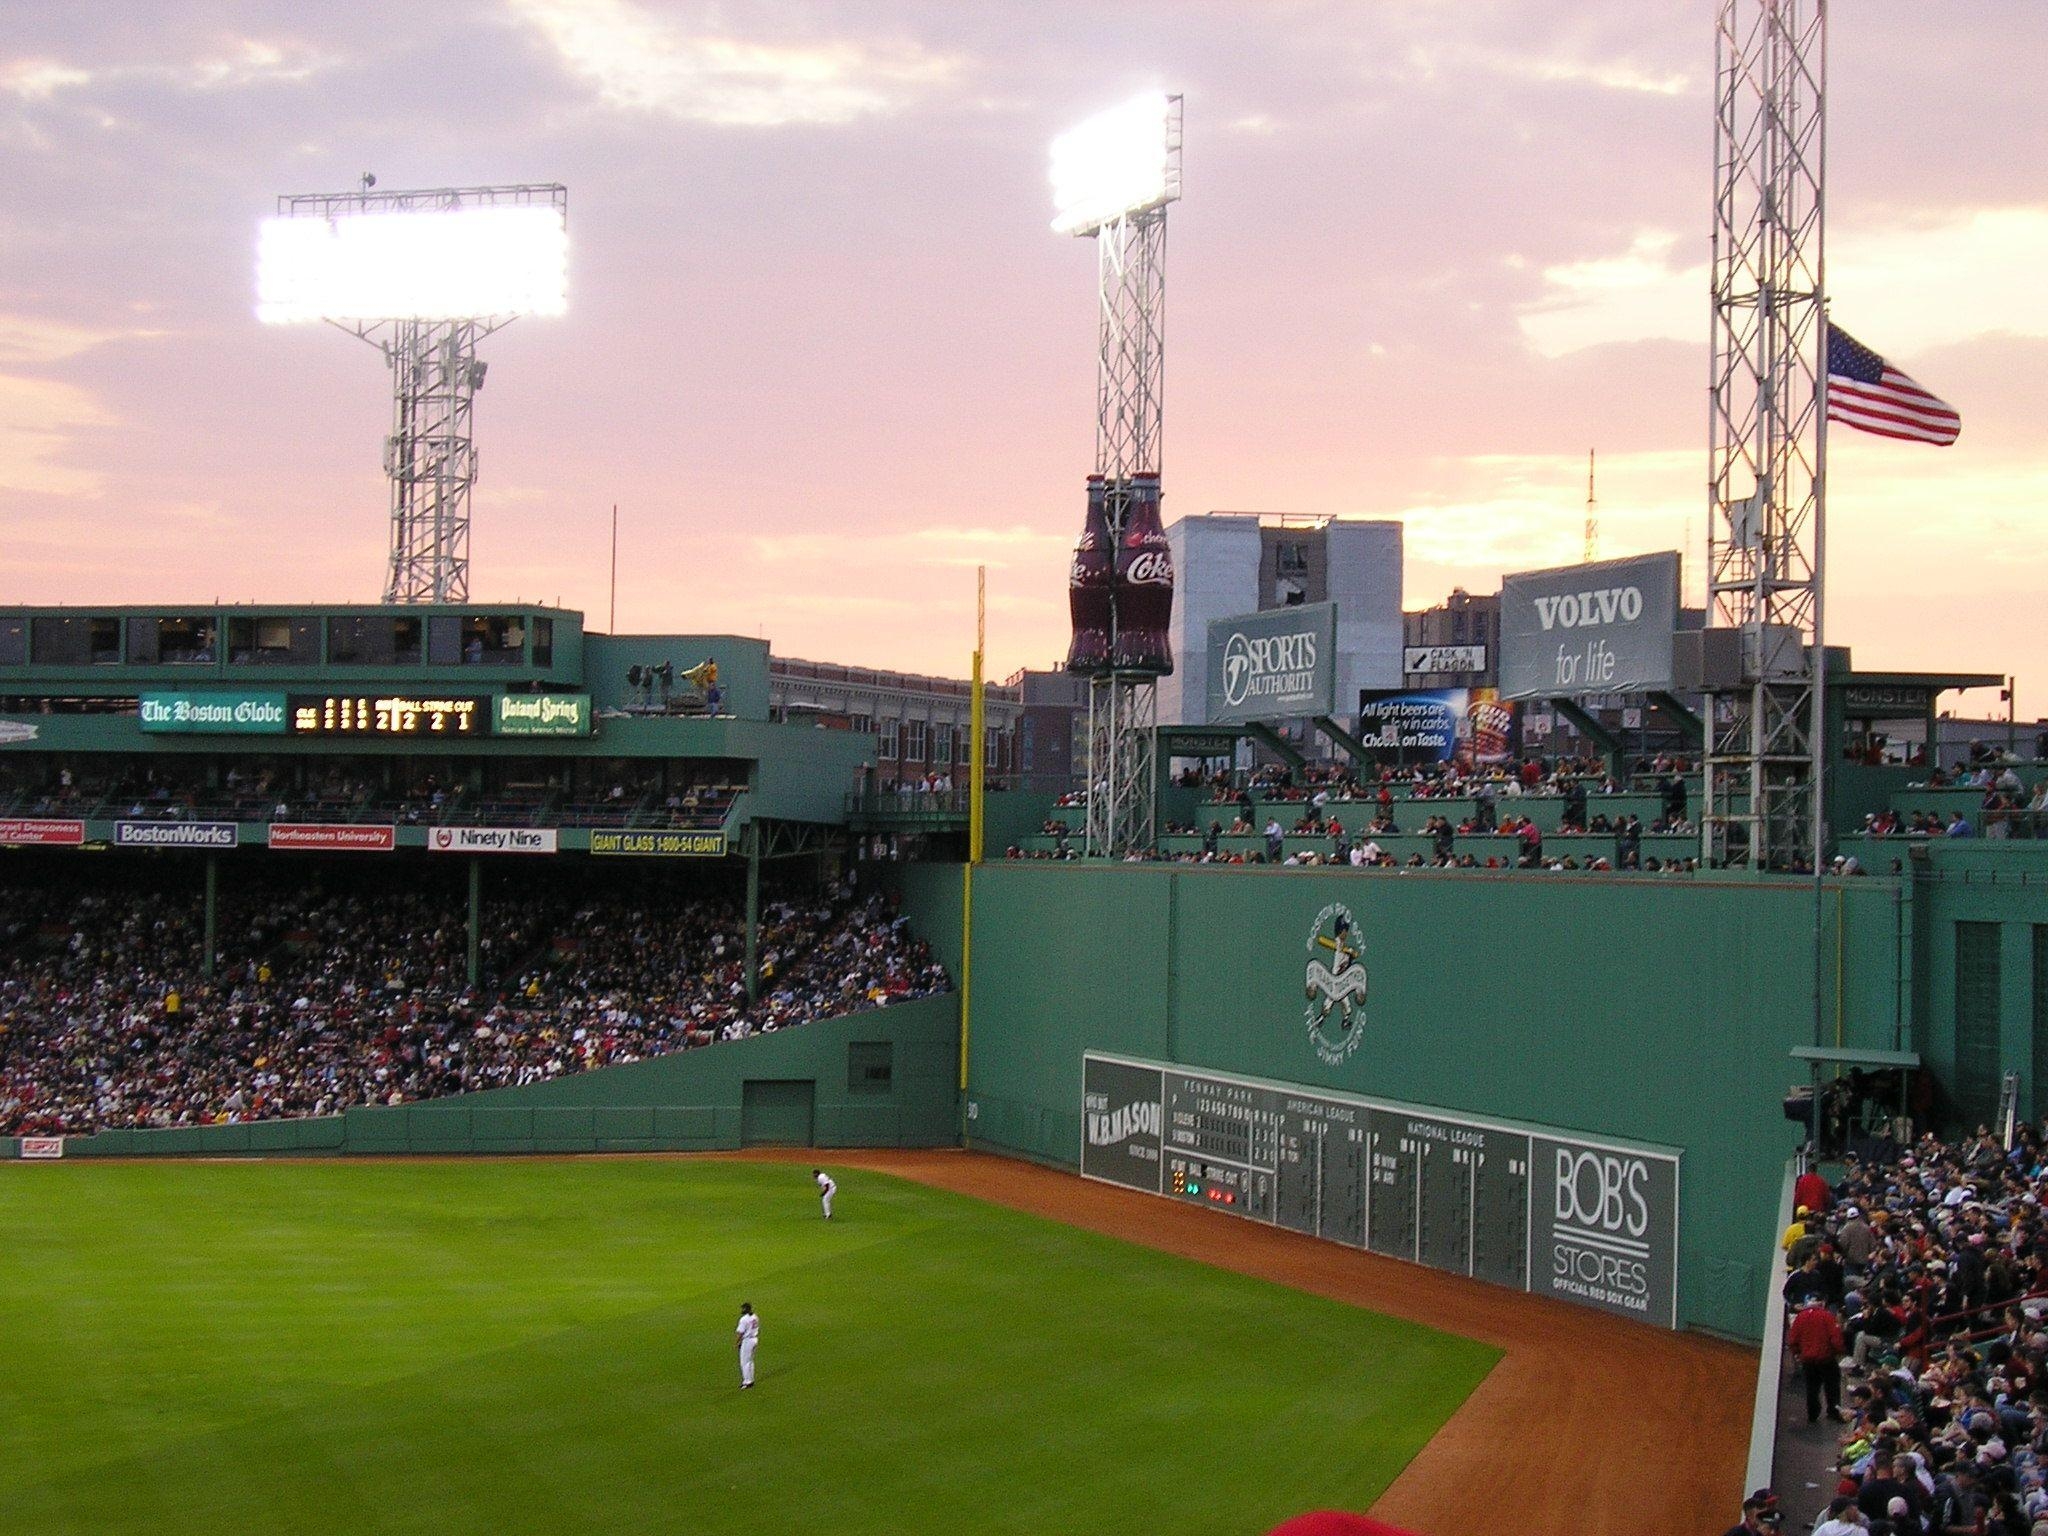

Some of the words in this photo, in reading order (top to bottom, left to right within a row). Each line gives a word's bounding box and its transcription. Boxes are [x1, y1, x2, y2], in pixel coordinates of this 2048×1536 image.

[1127, 552, 1173, 585] Coke
[1534, 586, 1643, 631] VOLVO
[1249, 631, 1318, 675] SPORTS
[1556, 643, 1581, 684] for
[1585, 639, 1616, 682] life
[1247, 671, 1315, 696] AUTHORITY
[142, 700, 171, 722] The
[174, 700, 232, 722] Boston
[234, 701, 282, 723] Globe
[376, 712, 388, 729] 2
[402, 712, 415, 729] 2
[431, 712, 443, 729] 2
[458, 713, 468, 729] 1
[502, 697, 541, 721] Poland
[541, 697, 579, 724] Spring
[1362, 703, 1377, 717] All
[1376, 701, 1400, 720] light
[1400, 701, 1428, 716] beers
[1428, 705, 1446, 716] are
[1411, 717, 1421, 729] in
[1402, 736, 1417, 748] on
[121, 824, 232, 844] BostonWorks
[272, 829, 334, 842] Northeastern
[337, 829, 387, 844] University
[461, 829, 506, 848] Ninety
[509, 830, 542, 846] Nine
[595, 834, 621, 850] GIANT
[623, 835, 655, 851] GLASS
[694, 836, 722, 852] GIANT
[1184, 1080, 1221, 1098] FENWAY
[1287, 1100, 1324, 1116] AMERICAN
[1326, 1106, 1355, 1123] LEAGUE
[1407, 1121, 1448, 1141] NATIONAL
[1451, 1130, 1485, 1148] LEAGUE
[1556, 1148, 1648, 1236] BOB'S
[1553, 1244, 1647, 1294] STORES
[1553, 1277, 1589, 1297] OFFICIAL
[1589, 1286, 1606, 1300] RED
[1606, 1291, 1623, 1305] SOX
[1624, 1295, 1648, 1311] GEAR
